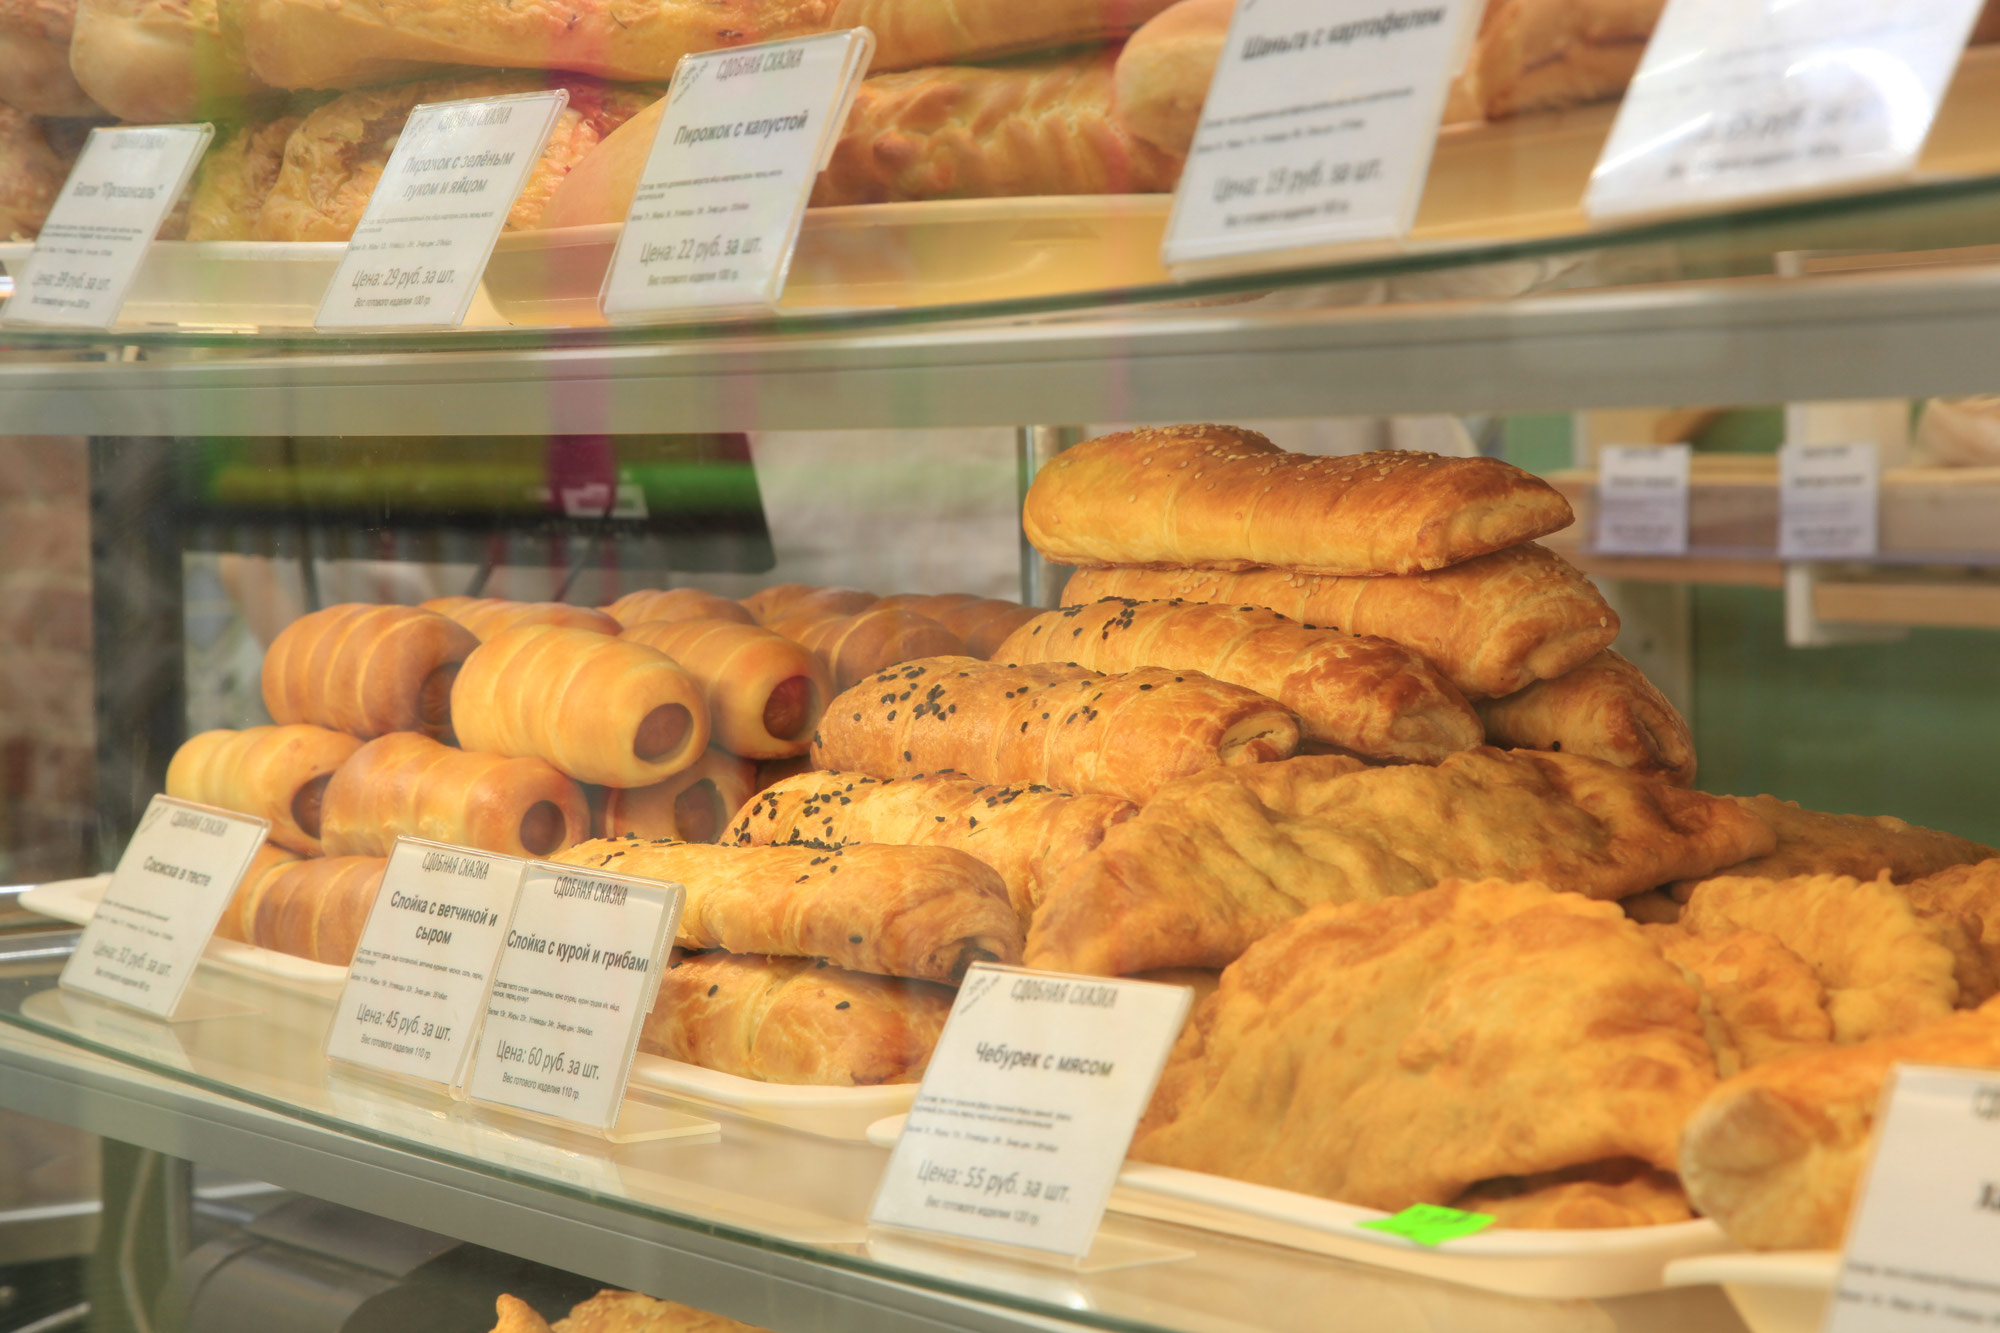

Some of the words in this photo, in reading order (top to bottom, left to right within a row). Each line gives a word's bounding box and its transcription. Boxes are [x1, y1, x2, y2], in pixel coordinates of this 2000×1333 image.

[716, 53, 762, 81] СДОБНАЯ
[762, 48, 804, 72] СКАЗКА
[673, 122, 733, 148] Пирожок
[733, 124, 742, 137] с
[743, 109, 809, 139] капустой
[403, 156, 451, 174] Пирожок
[452, 157, 459, 168] с
[461, 150, 515, 167] зелёным
[403, 183, 438, 201] луком
[439, 182, 447, 194] и
[449, 176, 488, 195] яйцом
[640, 241, 676, 266] Цена:
[678, 238, 694, 259] 22
[694, 235, 721, 266] руб.
[724, 239, 739, 256] за
[741, 236, 762, 255] шт.
[352, 270, 383, 290] Цена:
[384, 268, 400, 285] 29
[396, 266, 422, 288] руб.
[423, 271, 436, 284] за
[437, 270, 455, 284] шт.
[177, 869, 186, 881] в
[187, 871, 212, 887] тесте
[422, 852, 459, 875] СДОБНАЯ
[458, 858, 490, 880] СКАЗКА
[553, 876, 595, 901] СДОБНАЯ
[594, 883, 628, 906] СКАЗКА
[391, 890, 429, 915] Слойка
[429, 904, 436, 915] с
[437, 903, 489, 926] ветчиной
[488, 913, 498, 927] и
[415, 925, 452, 946] сыром
[507, 929, 547, 953] Слойка
[547, 942, 555, 955] с
[556, 941, 591, 964] курой
[591, 947, 600, 960] и
[356, 1003, 386, 1025] Цена:
[386, 1010, 400, 1028] 45
[397, 1015, 420, 1034] руб.
[422, 1021, 434, 1036] за
[434, 1025, 451, 1041] шт.
[361, 1033, 372, 1045] Вес
[371, 1037, 394, 1051] готового
[392, 1042, 414, 1056] изделия
[414, 1047, 424, 1059] 110
[496, 1040, 527, 1064] Цена:
[528, 1046, 542, 1066] 60
[541, 1051, 564, 1073] руб.
[567, 1058, 580, 1074] за
[582, 1062, 599, 1080] шт.
[975, 1041, 1040, 1072] Чебурек
[1043, 1056, 1051, 1069] с
[1056, 1057, 1114, 1077] мясом
[502, 1072, 513, 1084] Вес
[513, 1076, 537, 1090] готового
[537, 1080, 560, 1094] изделия
[562, 1084, 572, 1097] 110
[917, 1160, 962, 1185] Цена:
[963, 1166, 984, 1188] 55
[986, 1171, 1018, 1196] руб.
[1022, 1179, 1042, 1197] за
[1043, 1183, 1071, 1204] шт.
